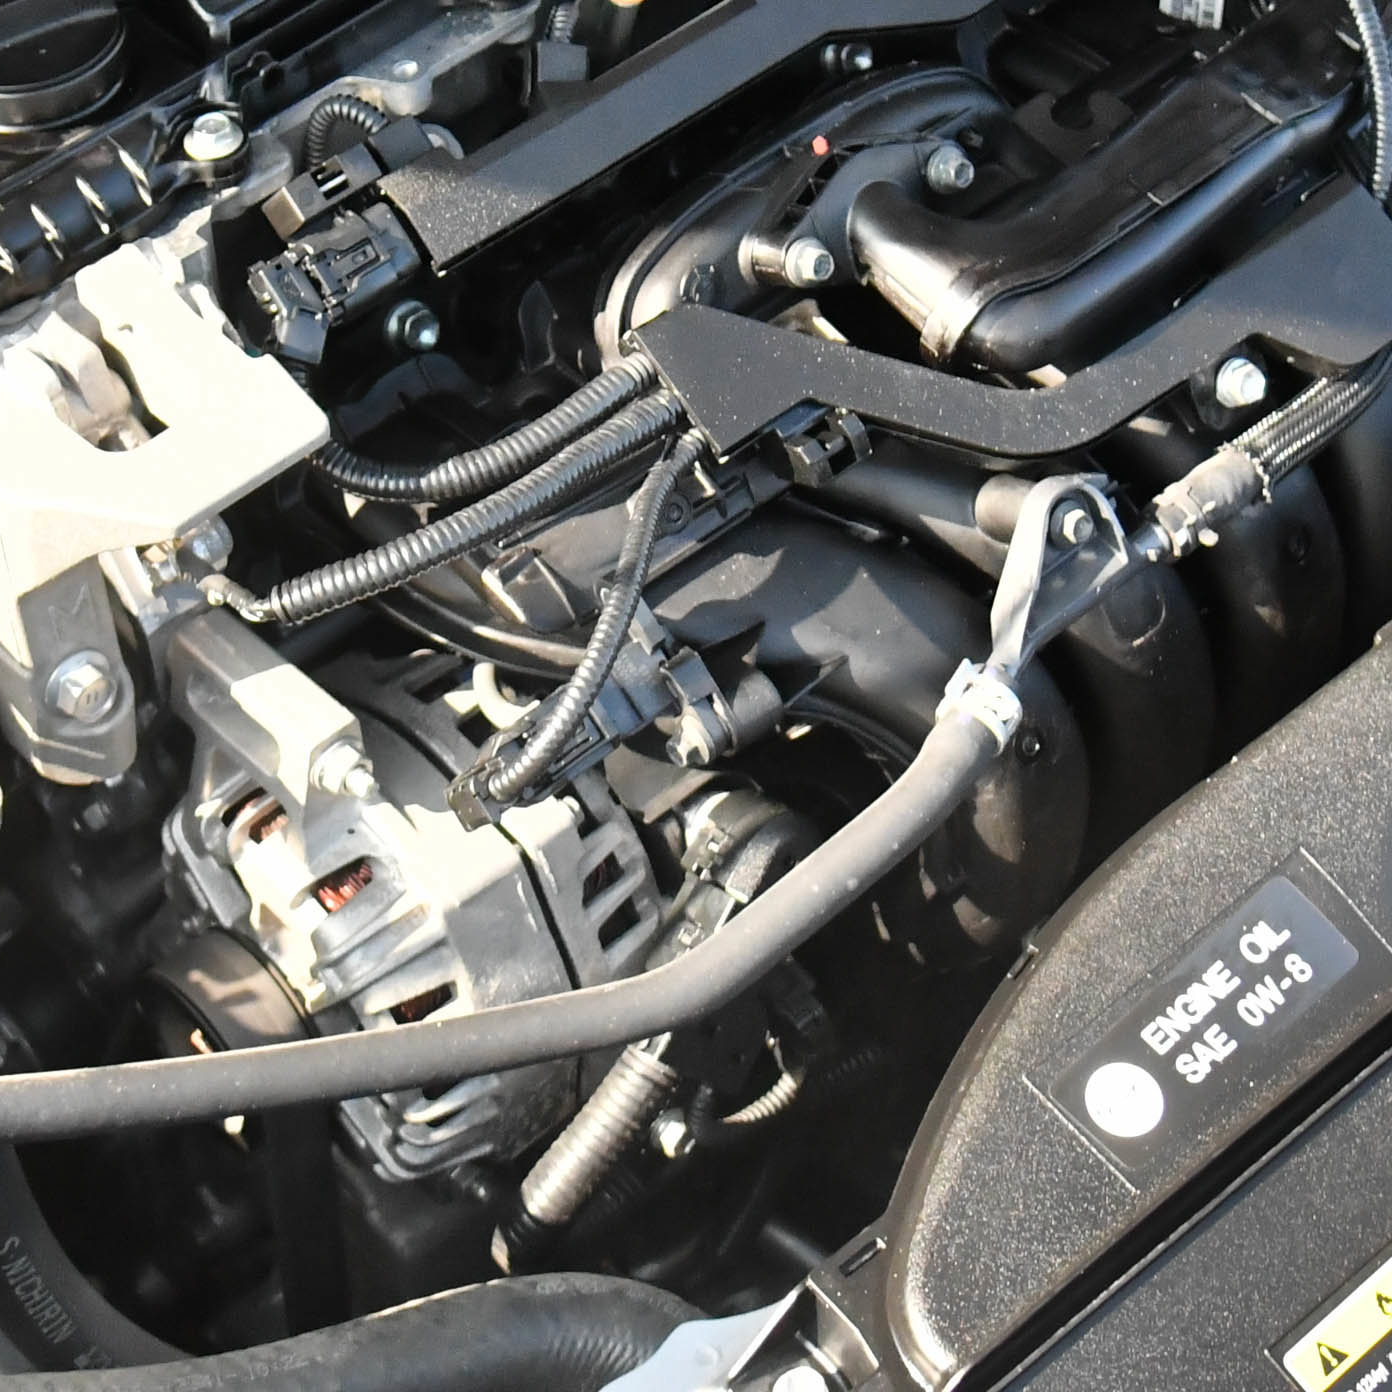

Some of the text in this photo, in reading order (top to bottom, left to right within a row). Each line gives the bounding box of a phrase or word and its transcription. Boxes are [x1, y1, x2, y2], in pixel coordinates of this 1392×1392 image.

[1140, 920, 1292, 1056] ENGINE OIL
[1175, 953, 1314, 1084] SAE 0W-8
